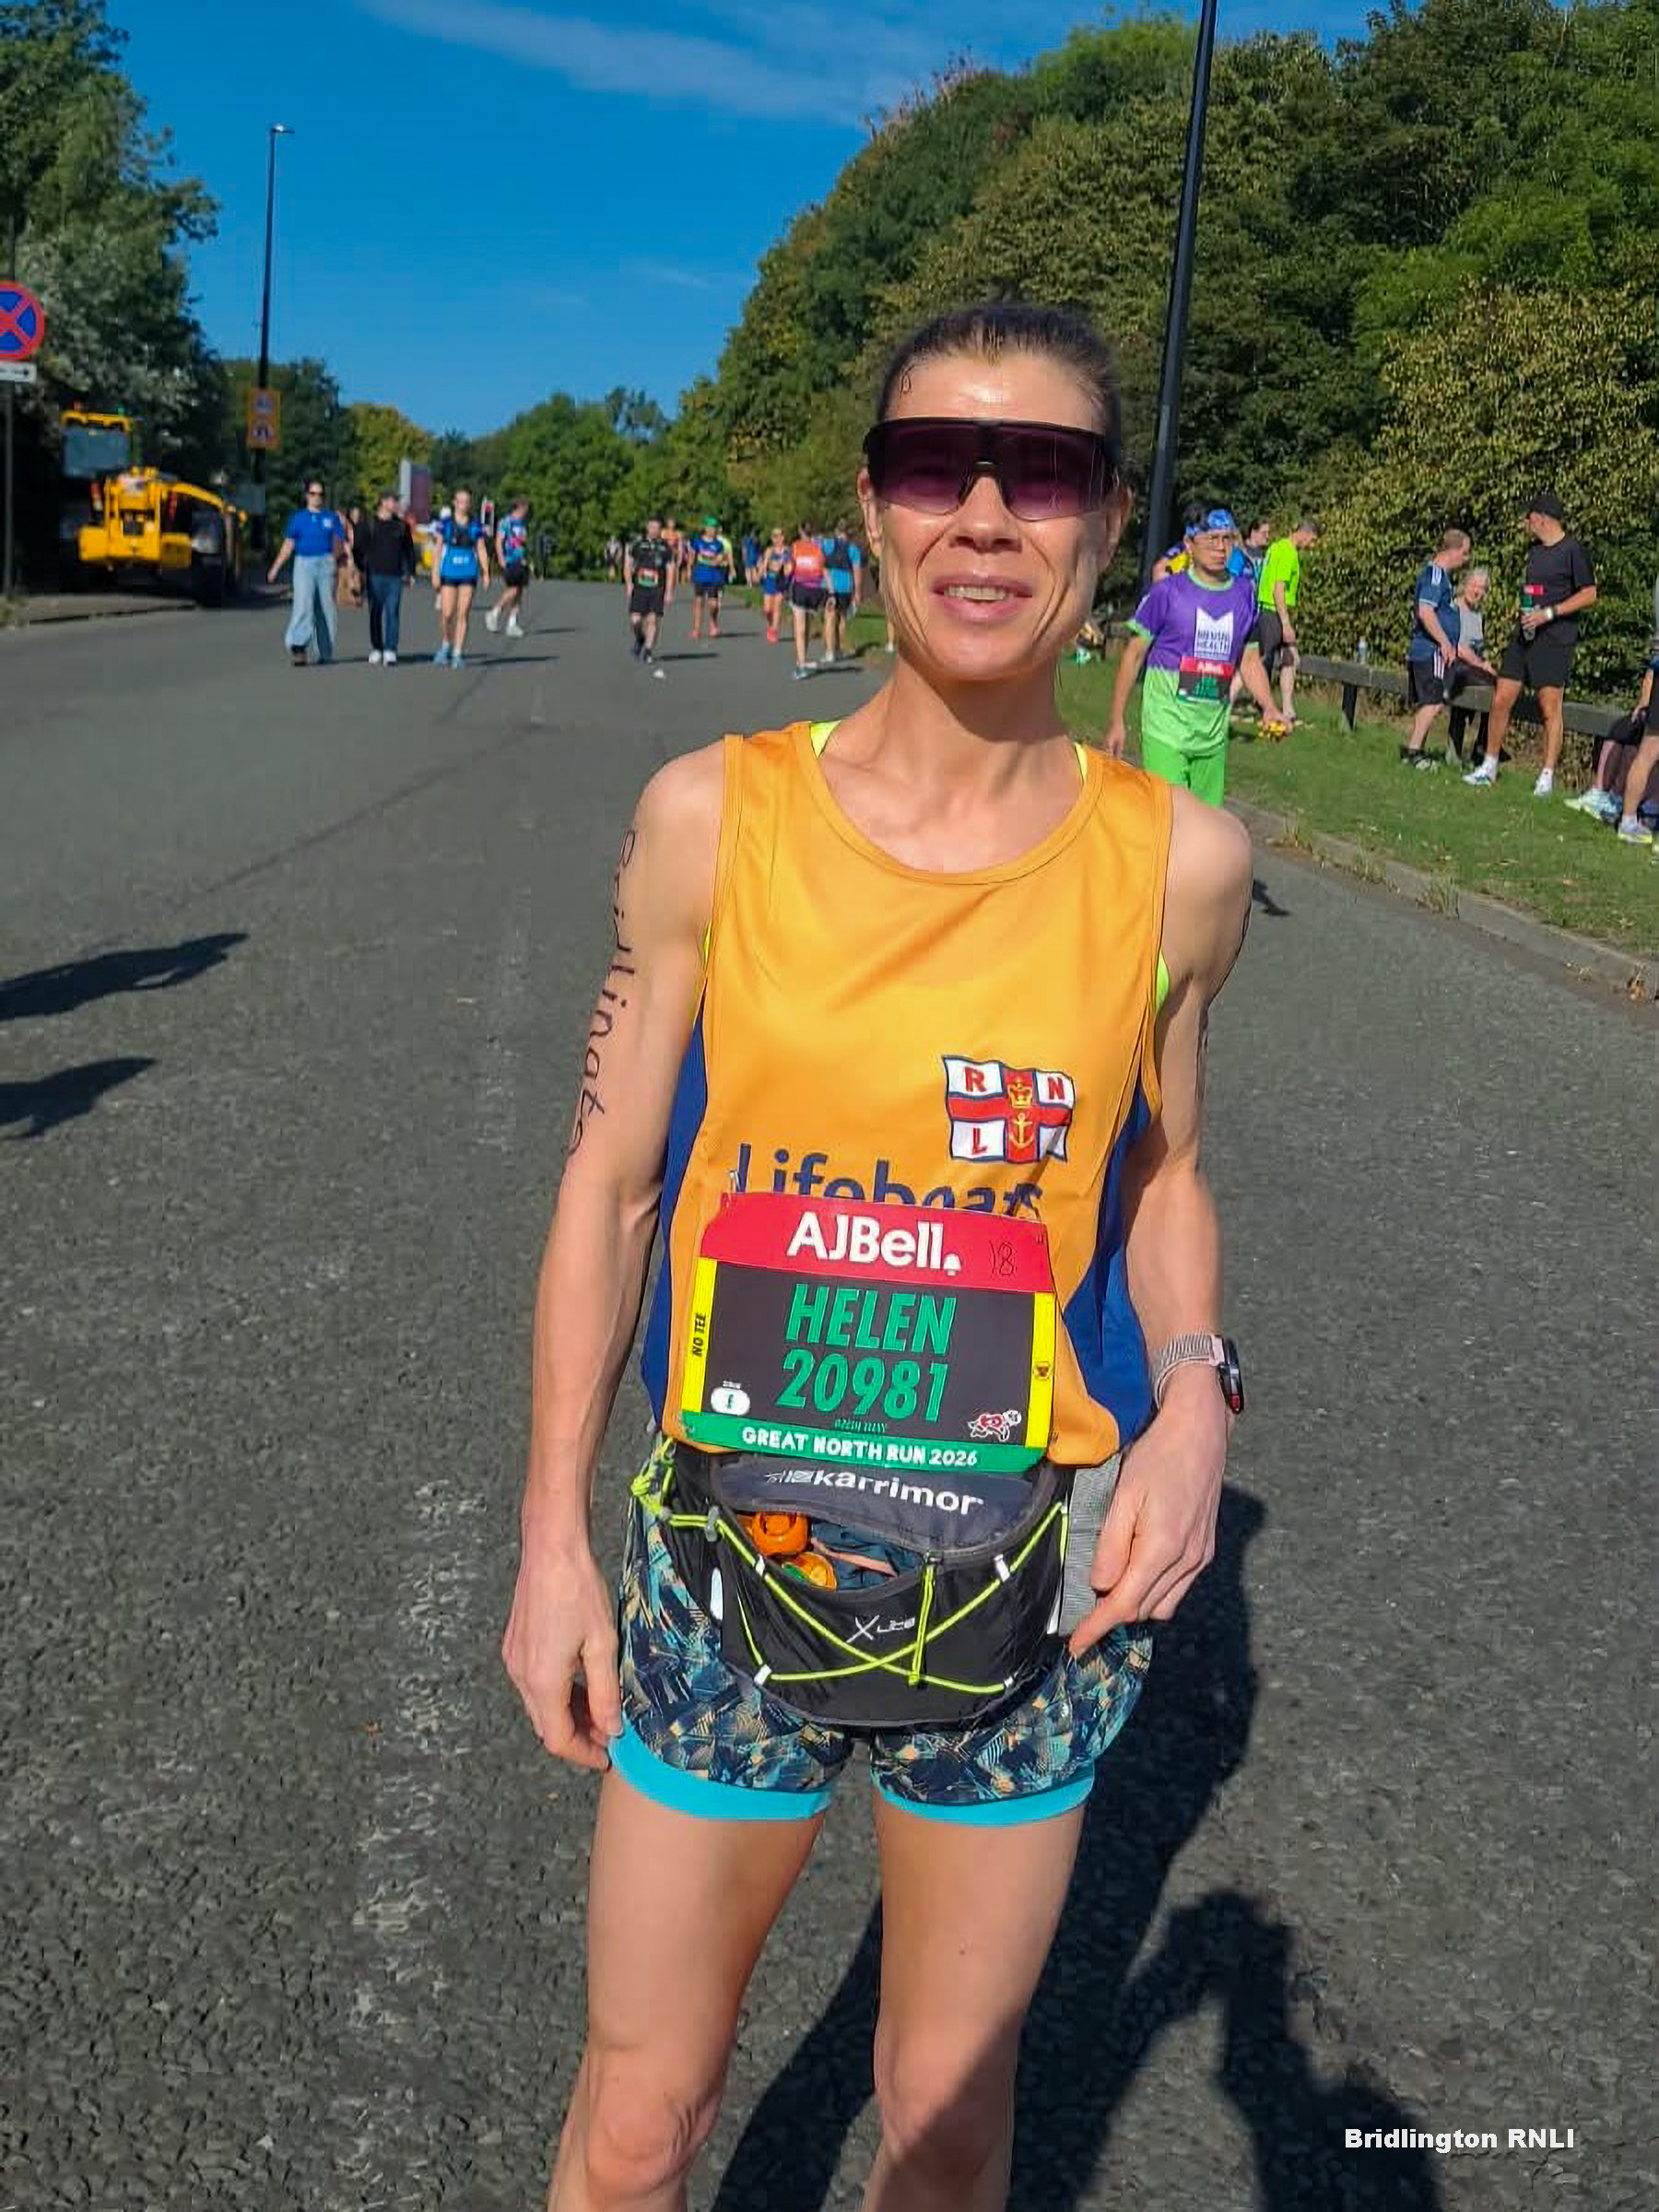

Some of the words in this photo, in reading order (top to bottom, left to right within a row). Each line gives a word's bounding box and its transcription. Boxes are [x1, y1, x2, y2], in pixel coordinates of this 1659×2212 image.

[965, 1066, 986, 1093] R
[1047, 1077, 1065, 1100] N
[972, 1127, 987, 1156] L
[785, 1282, 958, 1355] HELEN
[692, 1336, 704, 1358] NO
[775, 1348, 949, 1423] 20981
[742, 1426, 809, 1452] GREAT
[813, 1436, 882, 1461] NORTH
[886, 1443, 926, 1465] RUN
[929, 1449, 978, 1466] 2026
[814, 1469, 984, 1515] karrimor
